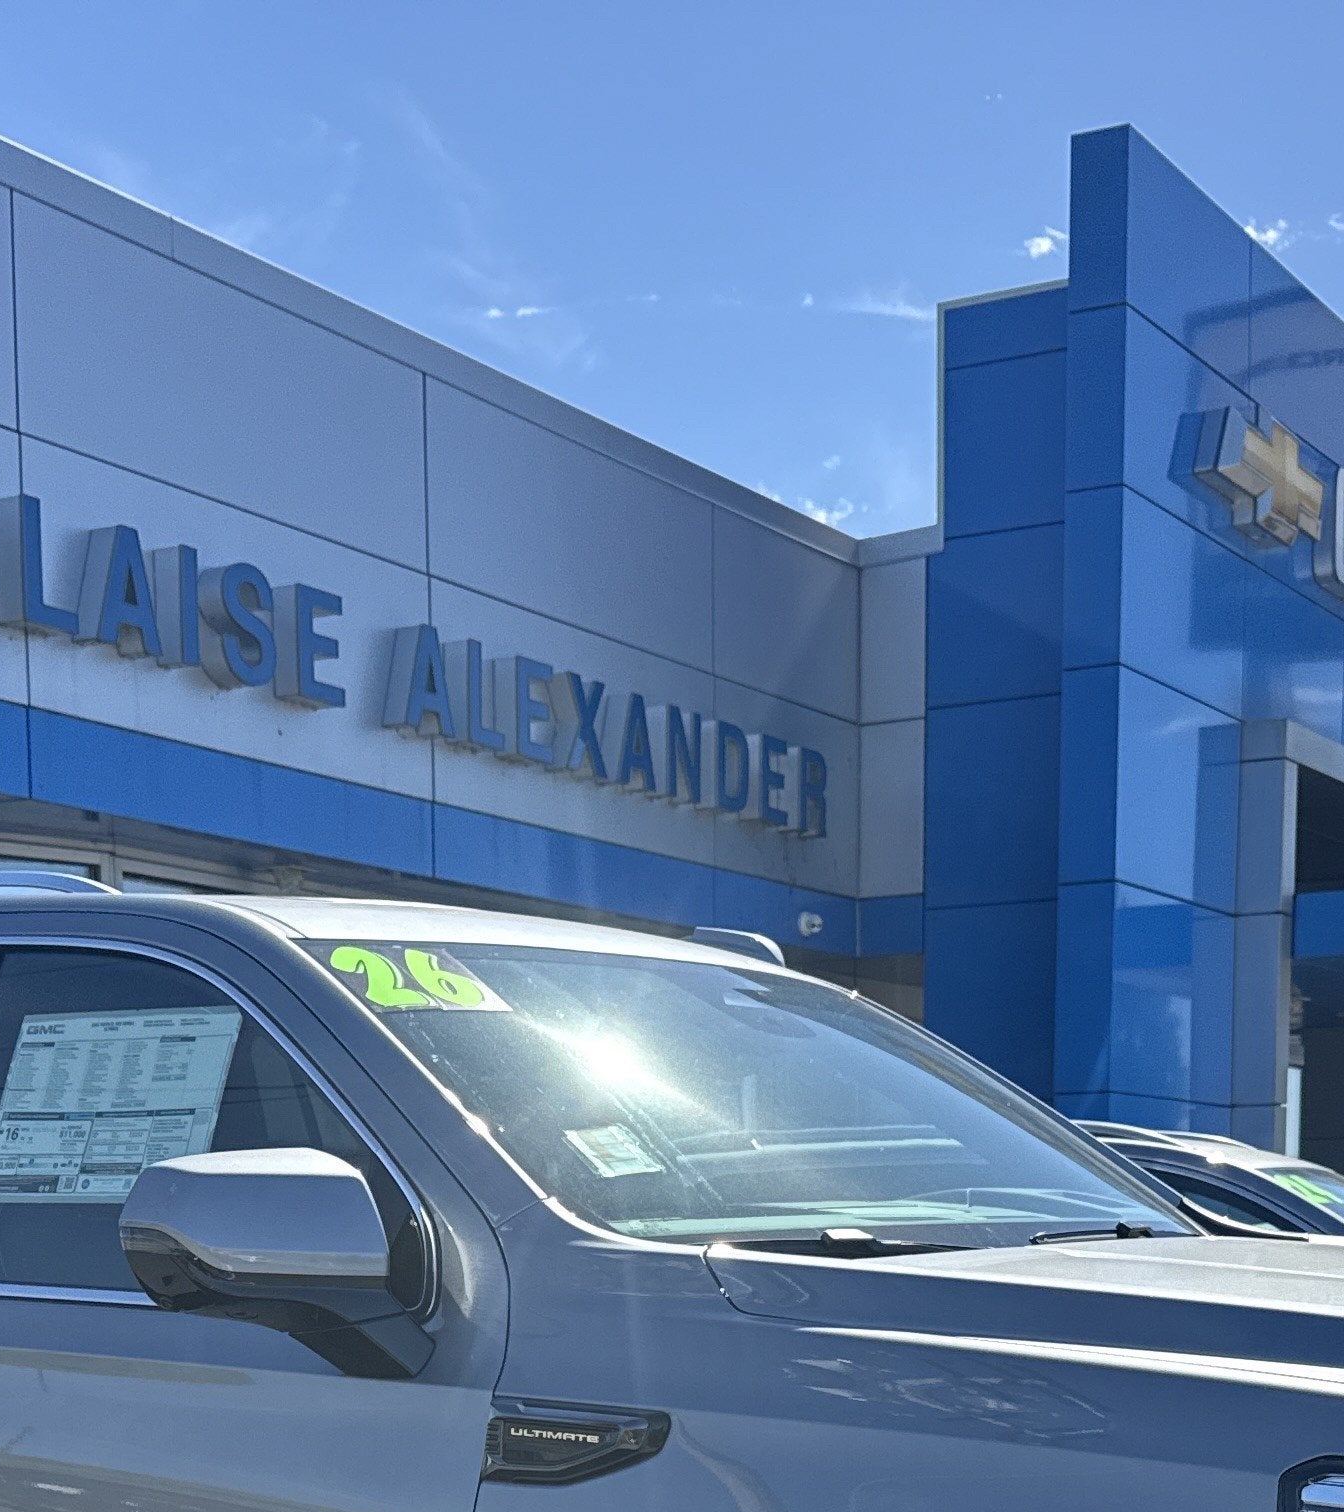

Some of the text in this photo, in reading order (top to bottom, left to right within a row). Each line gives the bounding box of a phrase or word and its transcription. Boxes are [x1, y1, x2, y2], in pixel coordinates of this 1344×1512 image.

[402, 624, 829, 840] ALEXANDER
[329, 946, 486, 1008] 26
[26, 1024, 65, 1035] GMC
[6, 1128, 19, 1141] 16
[510, 1427, 600, 1444] ULTIMATE
